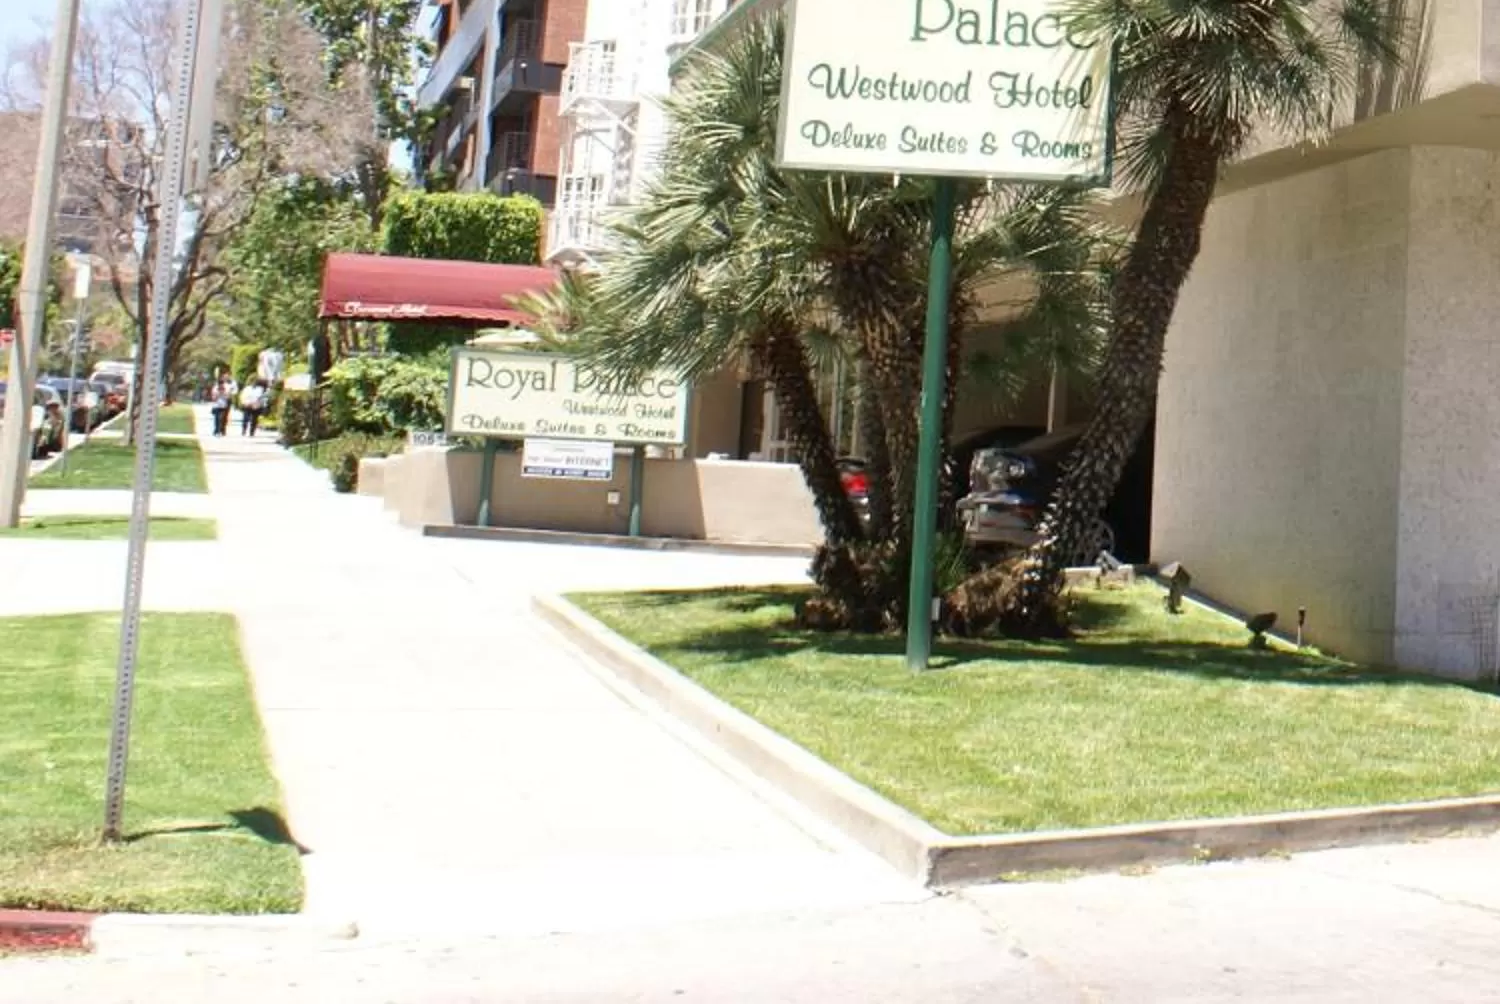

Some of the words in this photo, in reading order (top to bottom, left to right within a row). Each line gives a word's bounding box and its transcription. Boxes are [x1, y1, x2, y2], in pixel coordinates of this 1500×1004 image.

[808, 63, 972, 103] Westwood
[988, 70, 1092, 109] Hotel
[801, 120, 886, 151] Deluxe
[898, 125, 968, 154] Suites
[979, 132, 997, 155] &
[1012, 130, 1092, 159] Rooms
[466, 357, 558, 400] Royal
[461, 414, 526, 432] Deluxe
[536, 418, 586, 434] Suites
[617, 422, 676, 439] Rooms
[634, 402, 676, 419] Hotel
